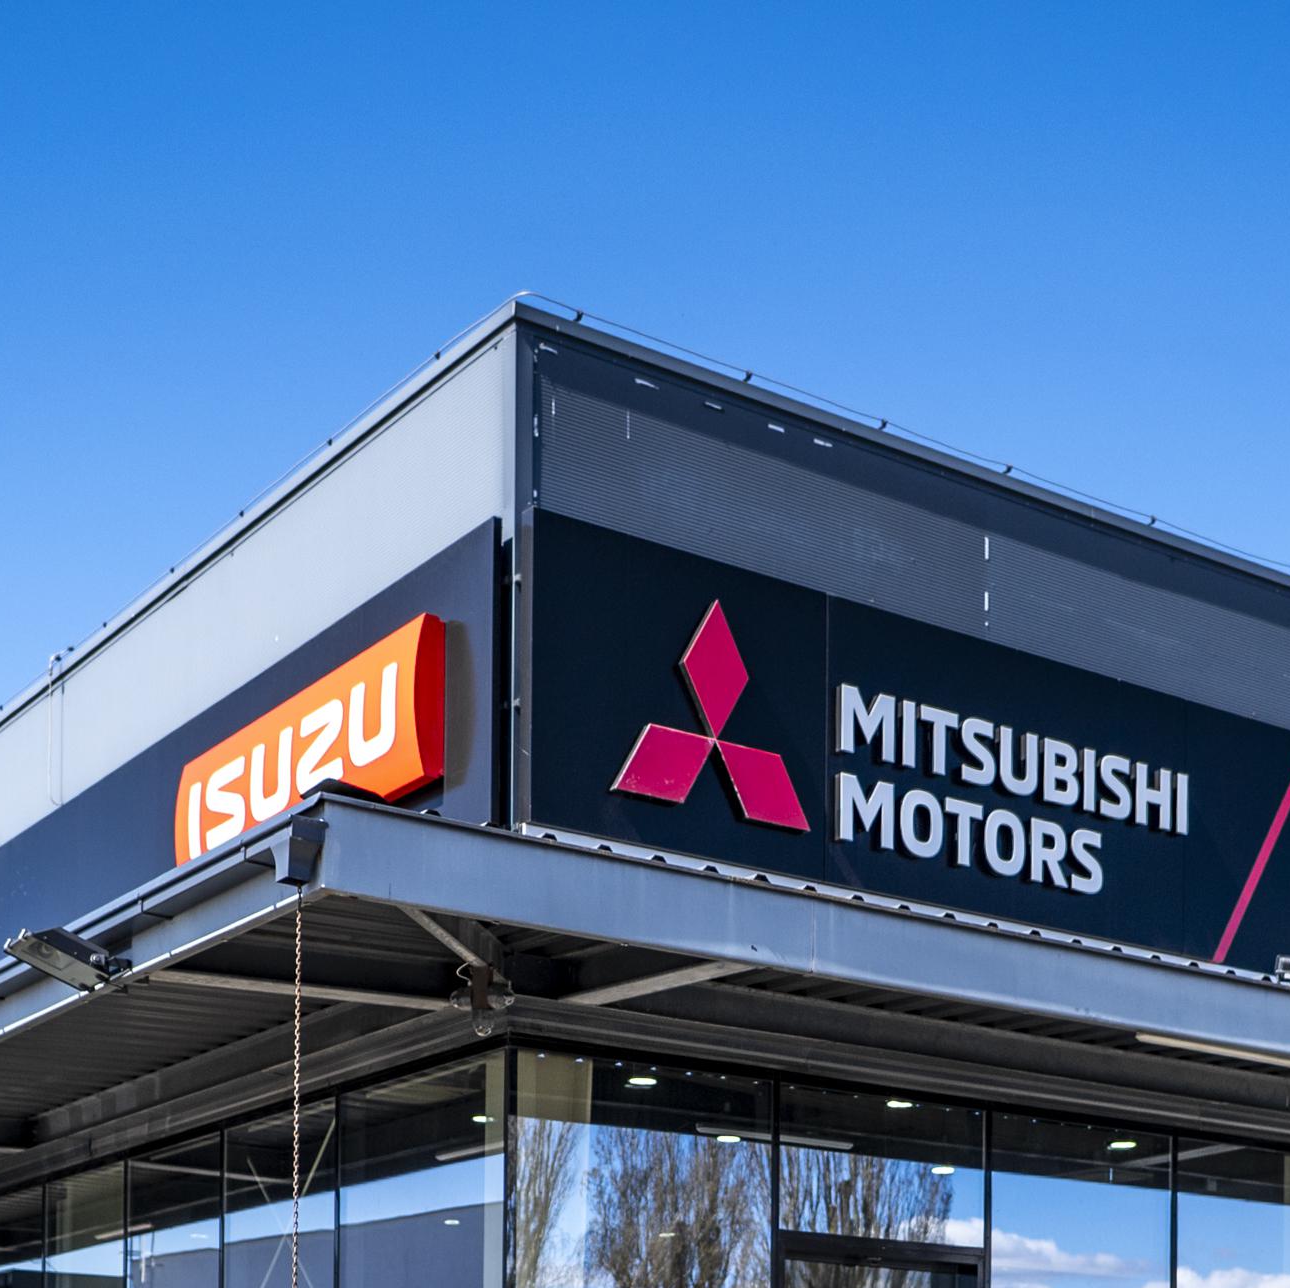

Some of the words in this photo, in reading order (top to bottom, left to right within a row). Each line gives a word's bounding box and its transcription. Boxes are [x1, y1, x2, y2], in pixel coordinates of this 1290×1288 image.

[188, 662, 398, 860] ISUZU
[835, 683, 1189, 835] MITSUBISHI
[835, 772, 1105, 894] MOTORS
